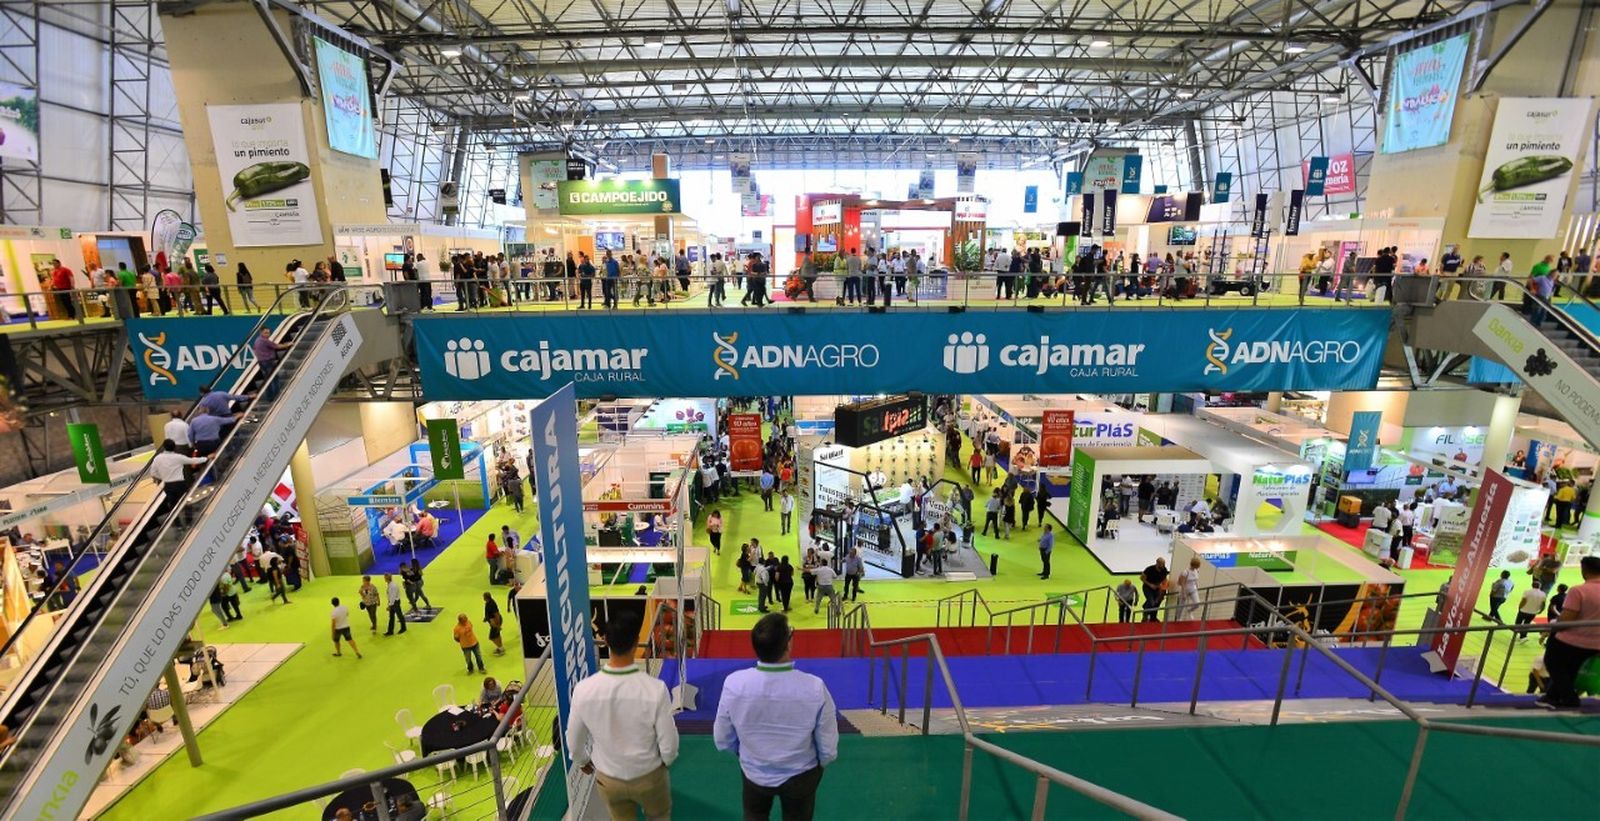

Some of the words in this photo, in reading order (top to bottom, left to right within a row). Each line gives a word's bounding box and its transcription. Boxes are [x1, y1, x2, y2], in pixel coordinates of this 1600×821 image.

[248, 147, 290, 159] pimiento
[1506, 143, 1519, 151] un
[1520, 141, 1561, 152] pimiento
[581, 191, 668, 203] CAMPOEJIDO
[176, 345, 258, 371] ADNA
[500, 341, 648, 381] cajamar
[741, 344, 880, 369] ADNAGRO
[999, 336, 1145, 375] cajamar
[1231, 339, 1361, 365] ADNAGRO
[574, 372, 605, 383] CAJA
[607, 371, 647, 382] RURAL
[1069, 367, 1099, 378] CAJA
[1101, 367, 1140, 377] RURAL
[1556, 380, 1571, 395] NO
[1073, 423, 1133, 438] turPláS
[134, 645, 155, 676] QUE
[152, 627, 166, 646] LO
[162, 605, 182, 629] DAS
[178, 572, 202, 604] TODO
[199, 546, 217, 573] POR
[212, 530, 228, 553] TU
[252, 443, 282, 486] MERECES
[278, 432, 289, 447] LO
[284, 406, 306, 437] MEJOR
[302, 391, 313, 409] DE
[309, 359, 335, 398] NOSOTROS
[545, 408, 577, 704] GRICULTURA
